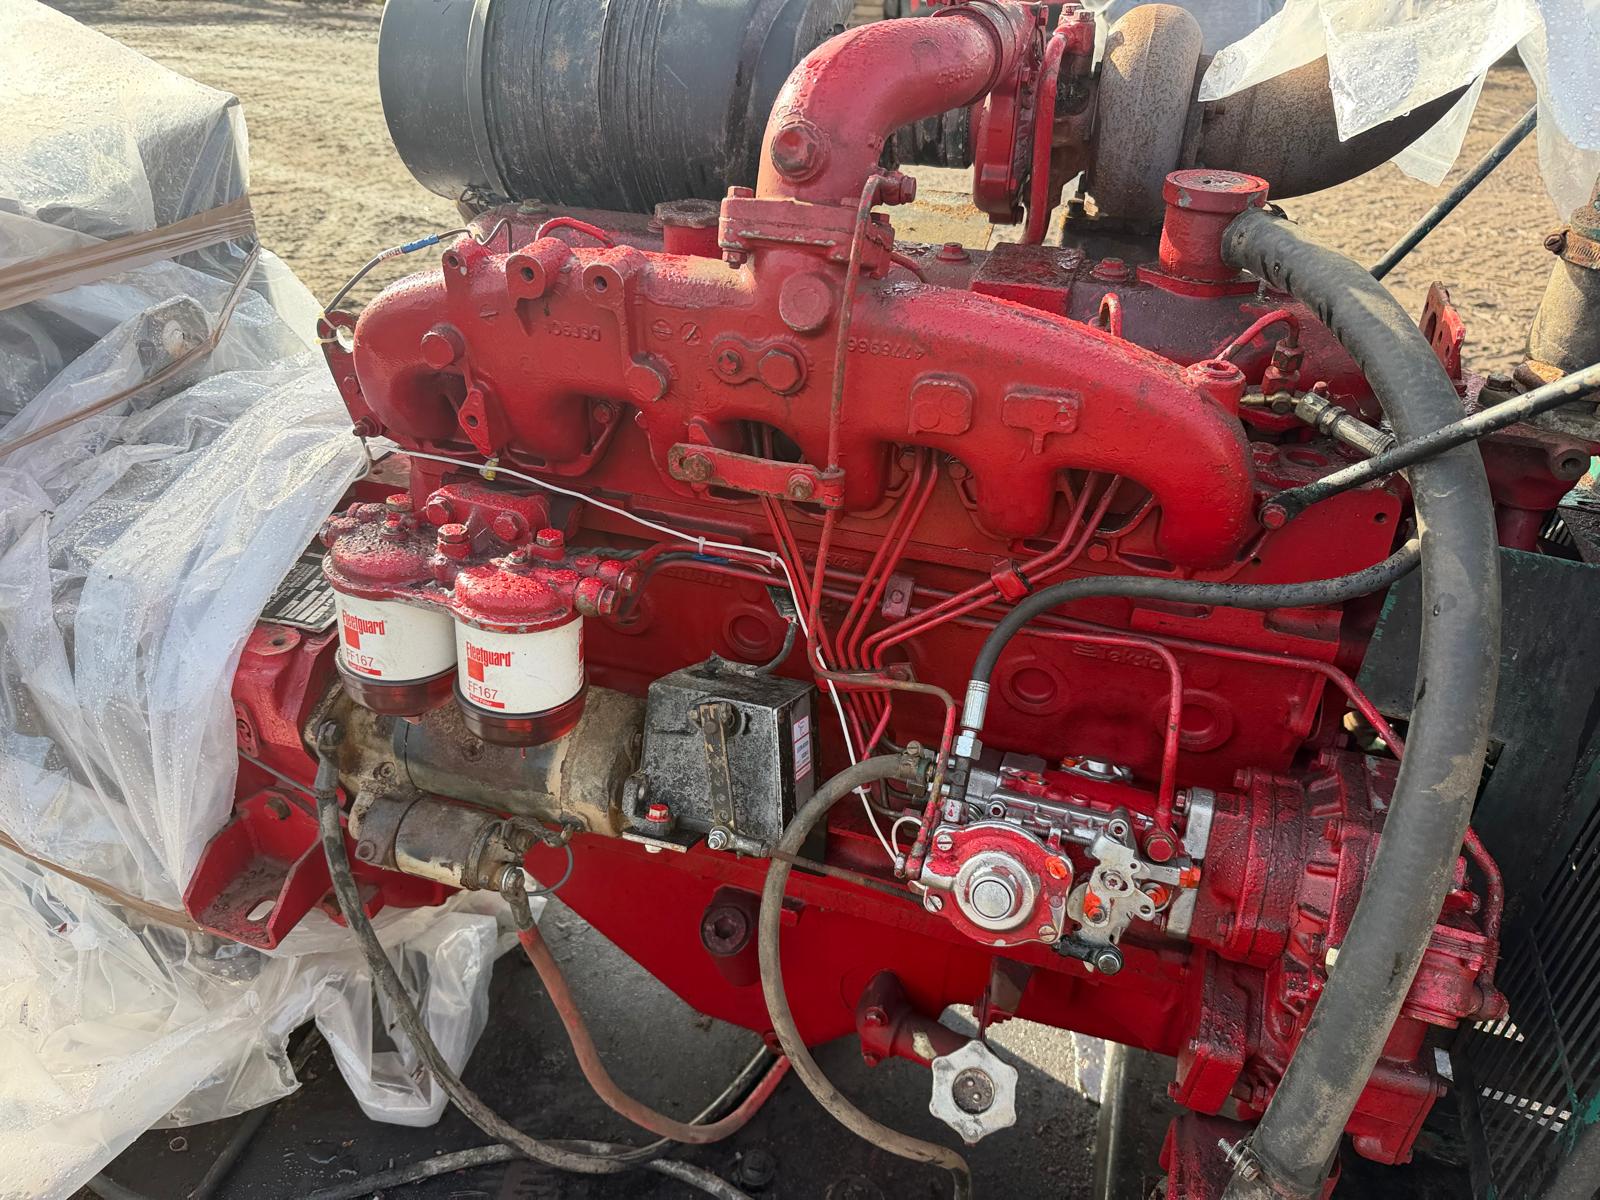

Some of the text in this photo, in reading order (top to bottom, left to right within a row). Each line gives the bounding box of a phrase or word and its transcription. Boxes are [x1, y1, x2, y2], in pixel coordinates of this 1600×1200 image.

[342, 609, 385, 635] Fleetguard
[346, 647, 374, 667] FF167
[466, 640, 511, 667] Fleetguard
[468, 680, 498, 700] FF167
